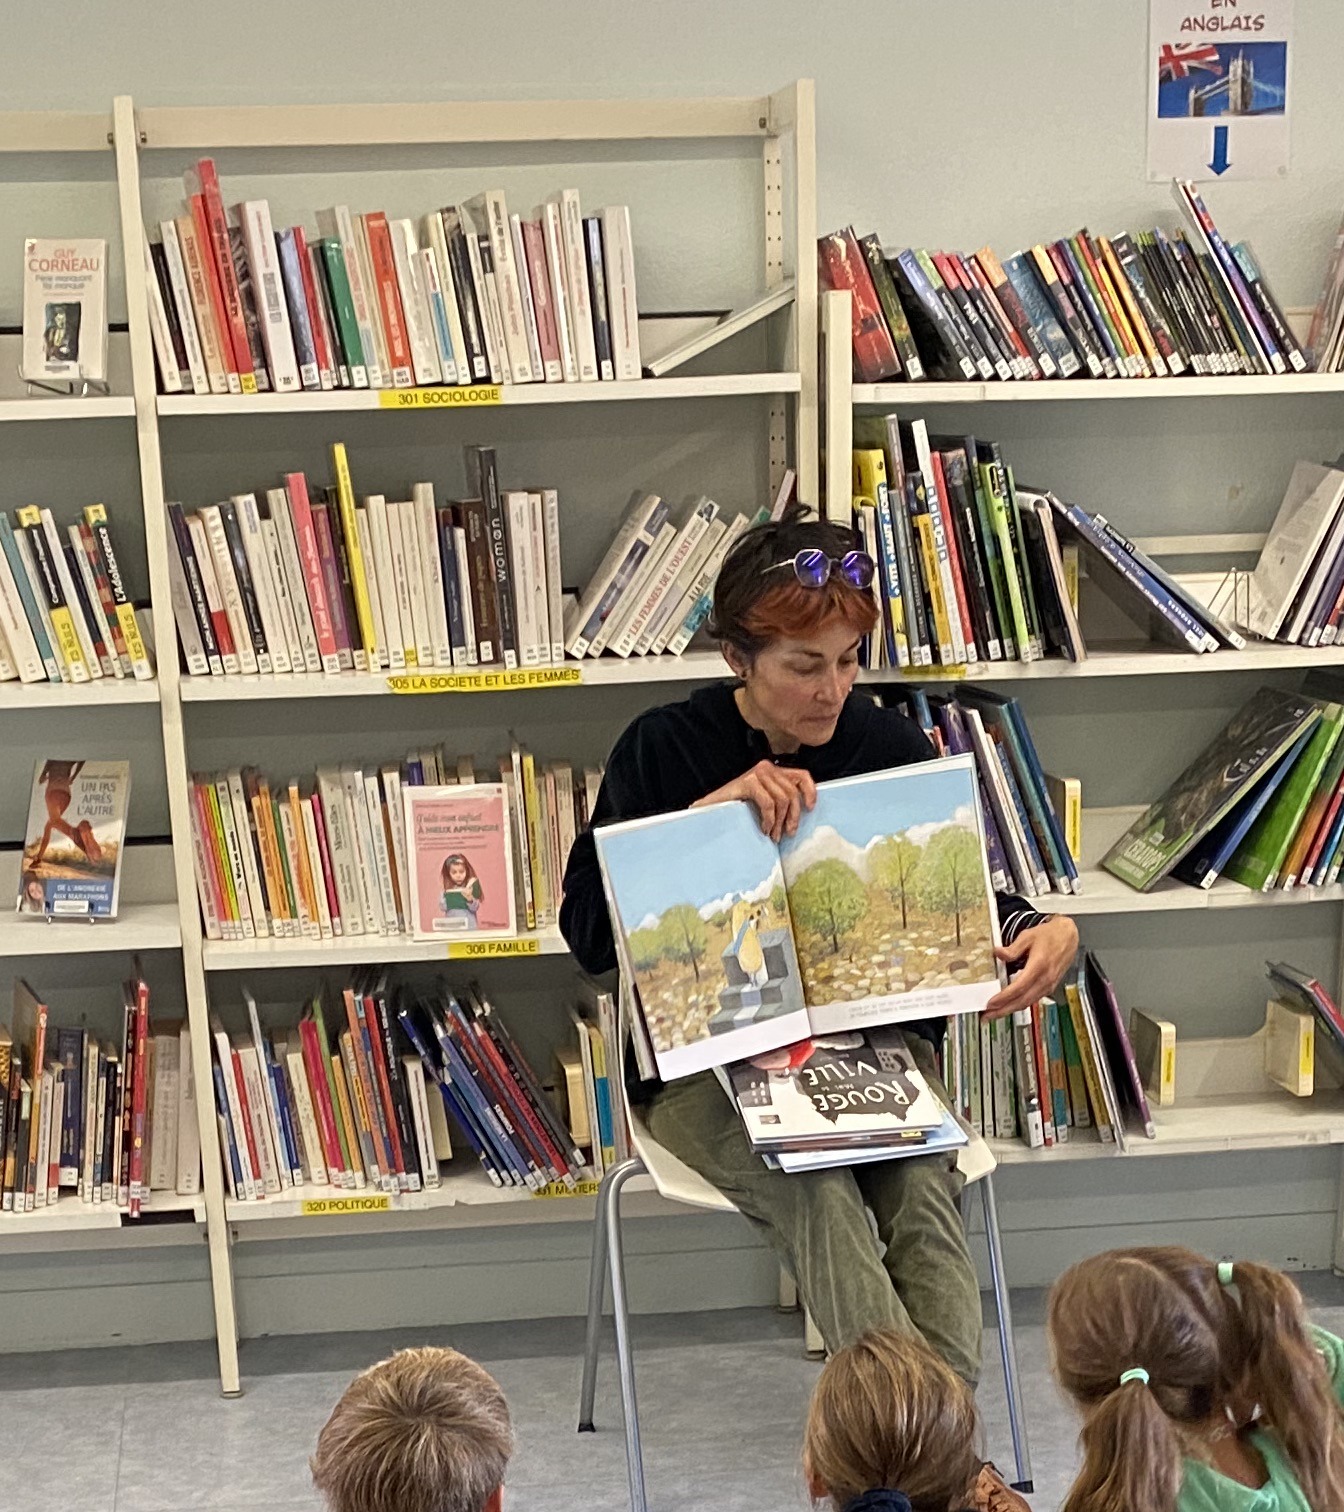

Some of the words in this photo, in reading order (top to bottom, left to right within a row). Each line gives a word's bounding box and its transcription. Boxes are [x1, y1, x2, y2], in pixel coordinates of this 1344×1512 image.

[1180, 14, 1265, 32] ANGLAIS
[53, 248, 77, 260] GUY
[29, 258, 100, 273] CORNEAU
[398, 393, 418, 405] 301
[422, 389, 499, 404] SOCIOLOGIE
[490, 516, 506, 582] woman
[94, 525, 128, 603] L'Adolescence
[628, 618, 643, 636] LES
[637, 584, 664, 620] FEMMES
[658, 572, 671, 587] DE
[665, 536, 693, 574] L'OUEST
[388, 677, 410, 690] 305
[412, 677, 426, 688] LA
[430, 675, 482, 688] SOCIETE
[484, 674, 501, 686] ET
[504, 672, 526, 684] LES
[528, 669, 580, 683] FEMMES
[81, 782, 96, 792] UN
[82, 792, 112, 804] APRÈS
[78, 805, 114, 816] L'AUTRE
[466, 944, 486, 954] 306
[488, 941, 536, 954] FAMILLE
[800, 1056, 877, 1086] VILLE
[808, 1078, 910, 1114] ROUGE
[306, 1202, 326, 1212] 320
[328, 1198, 388, 1210] POLITIQUE
